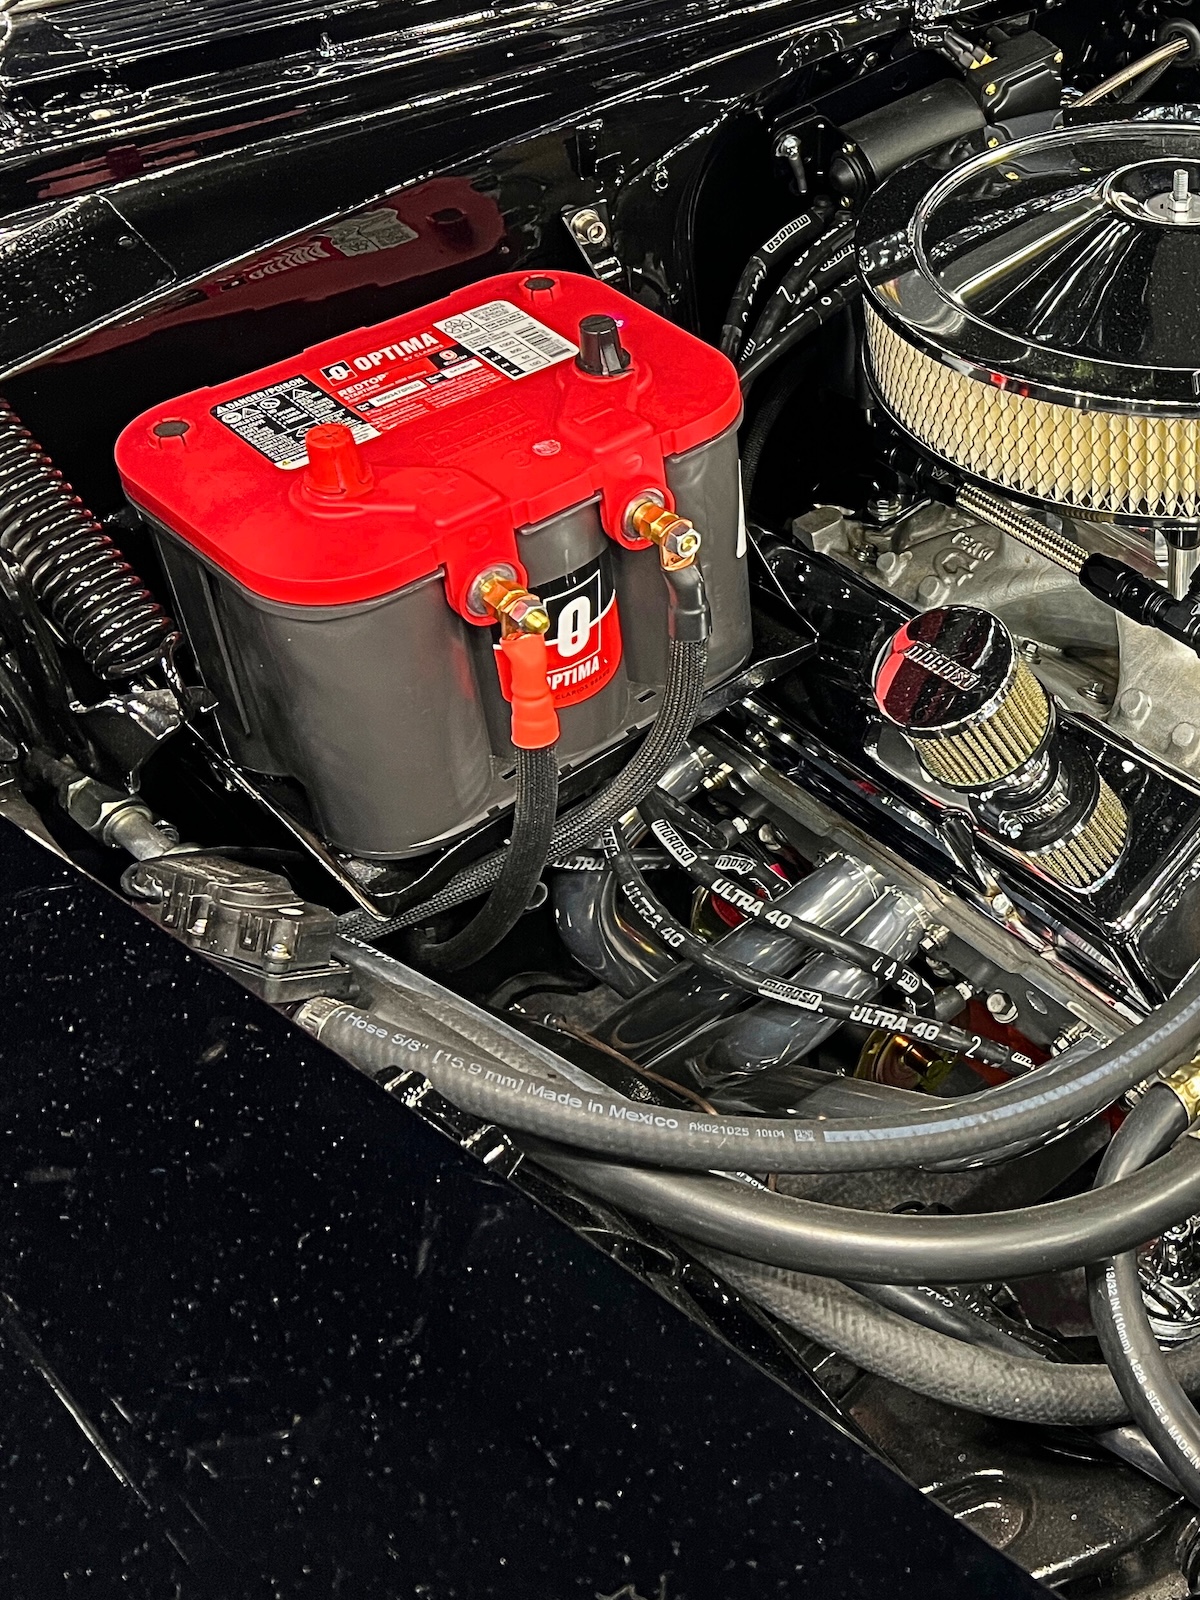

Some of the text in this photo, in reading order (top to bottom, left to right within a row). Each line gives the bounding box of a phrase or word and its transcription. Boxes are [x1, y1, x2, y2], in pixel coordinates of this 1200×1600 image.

[762, 214, 811, 253] MOROSO
[353, 332, 439, 371] OPTIMA
[337, 373, 386, 398] REDTOP
[546, 655, 600, 691] PTIMA
[651, 819, 698, 868] MOROSO
[622, 880, 664, 929] ULTRA
[660, 926, 687, 949] 40
[710, 878, 793, 930] ULTRA 40
[758, 978, 823, 1011] MOROSO
[850, 1005, 941, 1041] ULTRA 40
[964, 1035, 982, 1059] 2
[343, 1013, 388, 1038] Hose
[391, 1033, 430, 1052] 5/8"
[431, 1050, 483, 1075] [15.9
[484, 1069, 525, 1092] mm]
[526, 1082, 583, 1108] Made
[587, 1099, 604, 1114] in
[608, 1104, 679, 1129] Mexico
[1105, 1265, 1118, 1297] 13/32
[1109, 1296, 1122, 1312] IN
[1111, 1312, 1135, 1355] (10mm)
[1145, 1389, 1166, 1417] SIZE
[1160, 1414, 1170, 1425] 8
[1167, 1424, 1194, 1459] MADE
